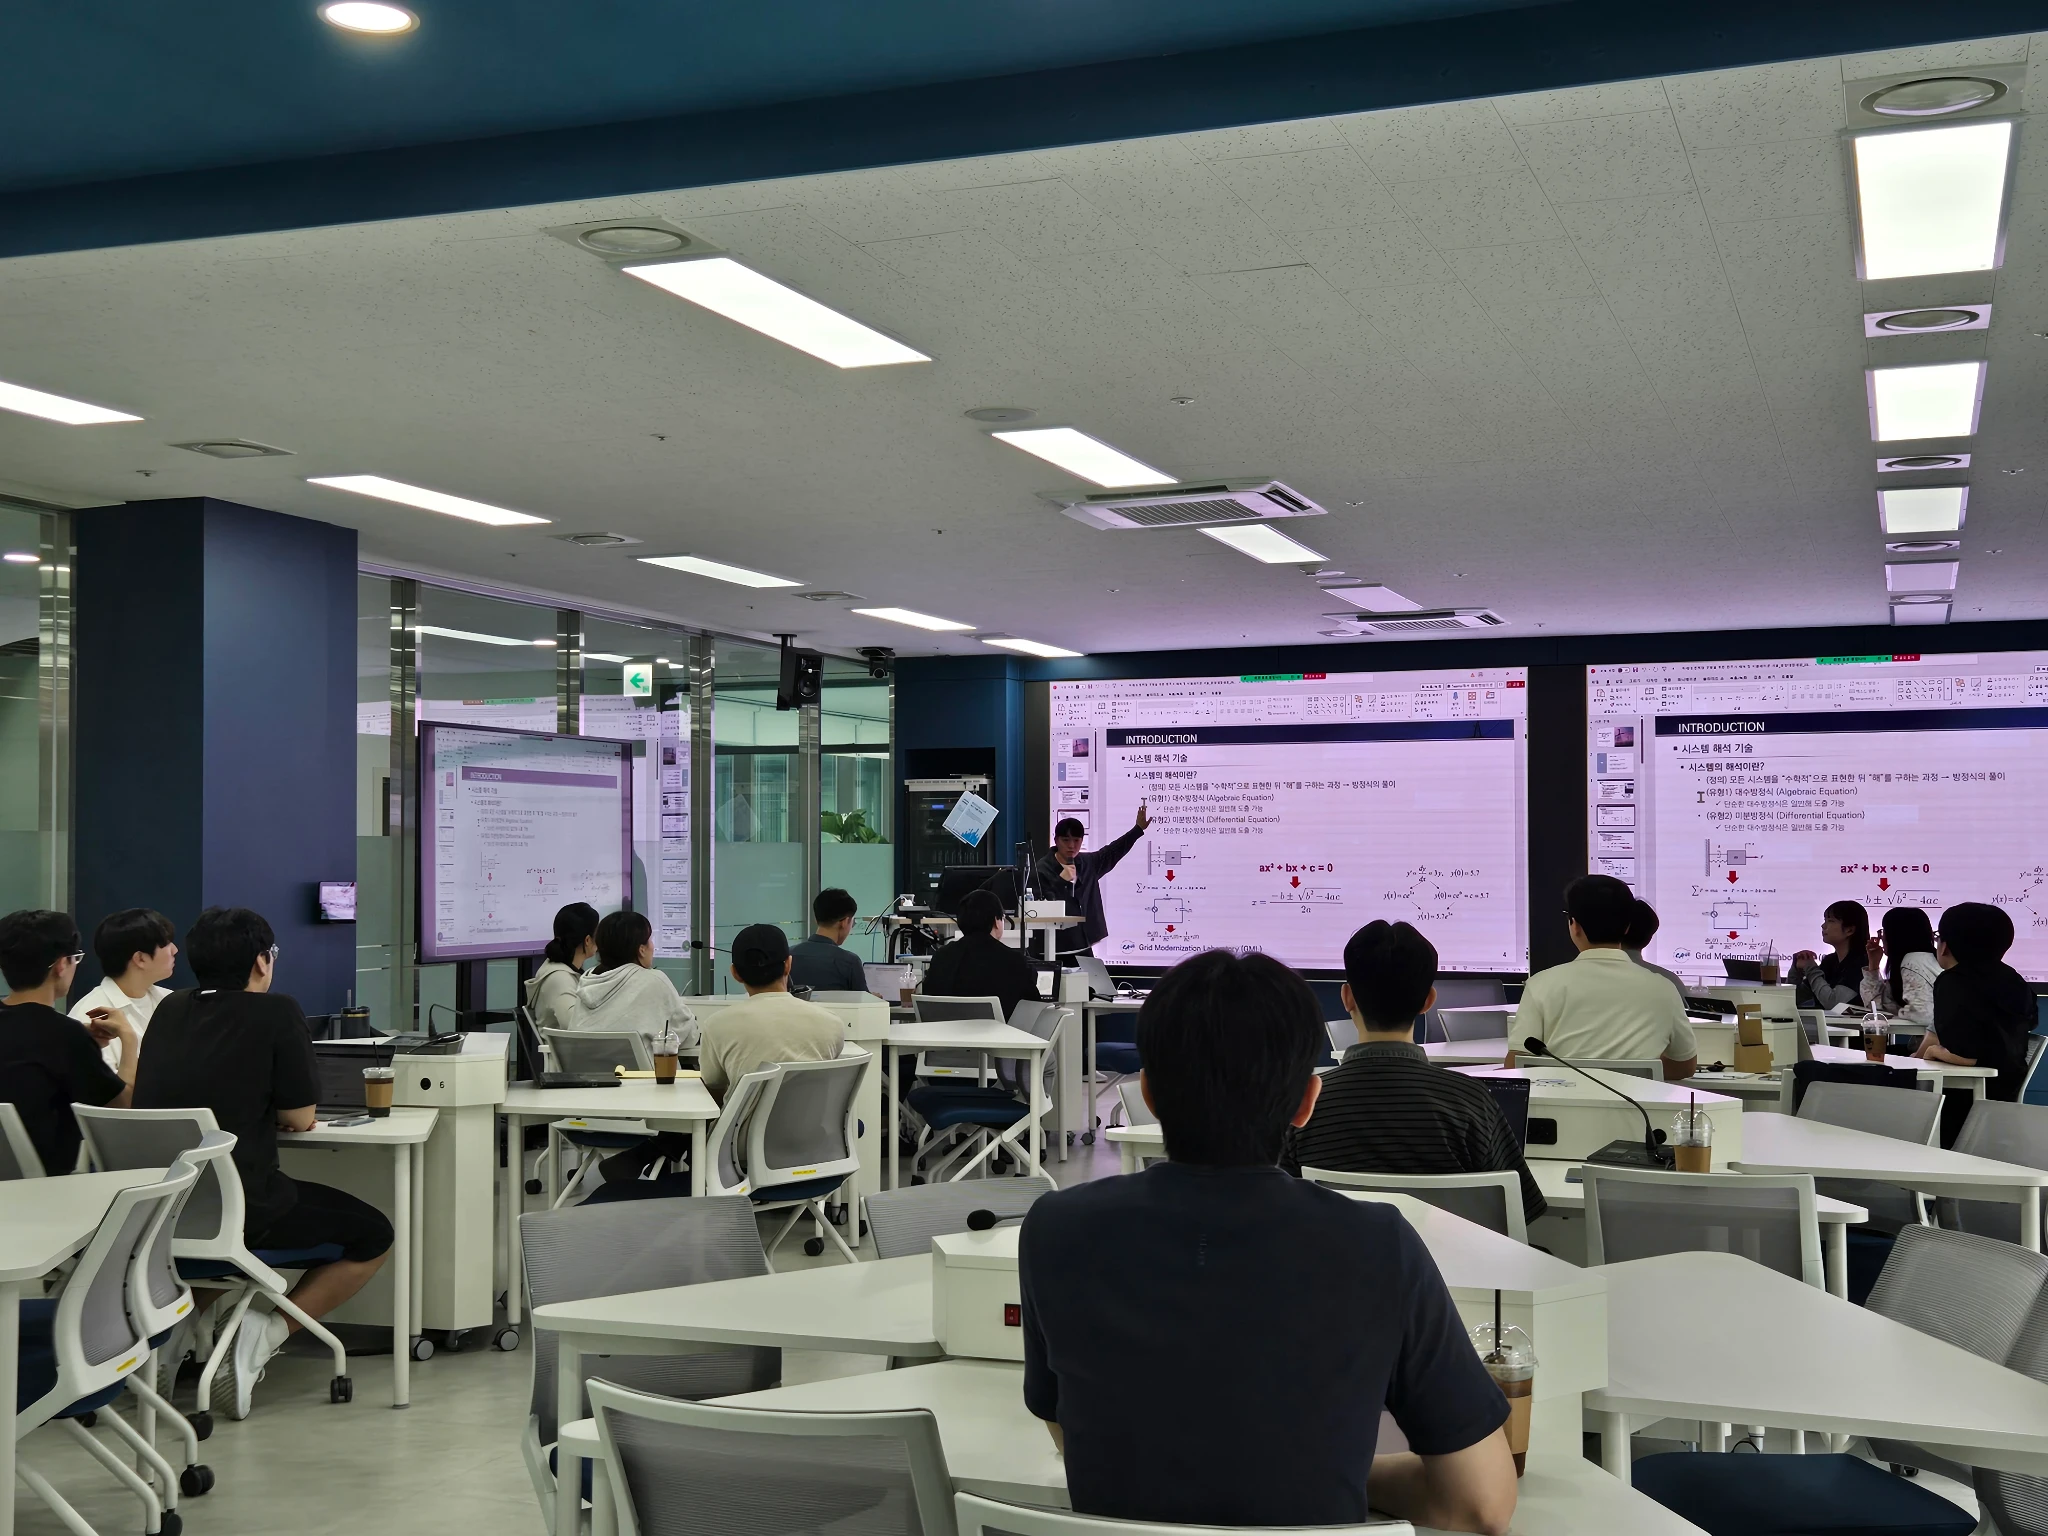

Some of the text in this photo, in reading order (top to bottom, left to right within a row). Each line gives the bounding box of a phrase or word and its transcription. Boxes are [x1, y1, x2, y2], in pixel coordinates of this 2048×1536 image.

[1678, 722, 1765, 733] INTRODUCTION
[1125, 734, 1198, 745] INTRODUCTION
[1681, 743, 1753, 754] 시스템 해석 기술
[1128, 753, 1188, 763] 시스템 해석 기술
[1688, 762, 1765, 772] 시스템의 해석이란?
[1134, 771, 1198, 780] 시스템의 해석이란?
[1706, 776, 1728, 785] (정의)
[1729, 776, 1745, 784] 모든
[1748, 775, 1778, 784] 시스템을
[1831, 774, 1855, 783] 표현한
[1895, 773, 1919, 782] 구하는
[1922, 773, 1939, 782] 과정
[1952, 772, 1986, 782] 방정식의
[1988, 772, 2006, 781] 풀이
[1168, 783, 1181, 791] 모든
[1183, 783, 1209, 791] 시스템을
[1252, 781, 1272, 790] 표현한
[1304, 781, 1325, 790] 구하는
[1327, 781, 1341, 790] 과정
[1352, 780, 1380, 789] 방정식의
[1382, 780, 1396, 789] 풀이
[1706, 787, 1858, 797] (유형1) 대수방정식 (Algebraic Equation)
[1206, 794, 1240, 803] (Algebraic
[1241, 793, 1275, 803] Equation)
[1206, 816, 1246, 824] (Differential
[1247, 815, 1281, 824] Equation)
[1706, 811, 1866, 820] (유형2) 미분방정식 (Differential Equation)
[1285, 863, 1298, 872] bx
[1872, 863, 1887, 873] bx
[1901, 865, 1908, 873] c
[1922, 863, 1930, 873] 0
[1138, 943, 1153, 951] Grid
[1154, 943, 1201, 952] Modernization
[1695, 952, 1712, 960] Grid
[439, 1080, 445, 1089] 6
